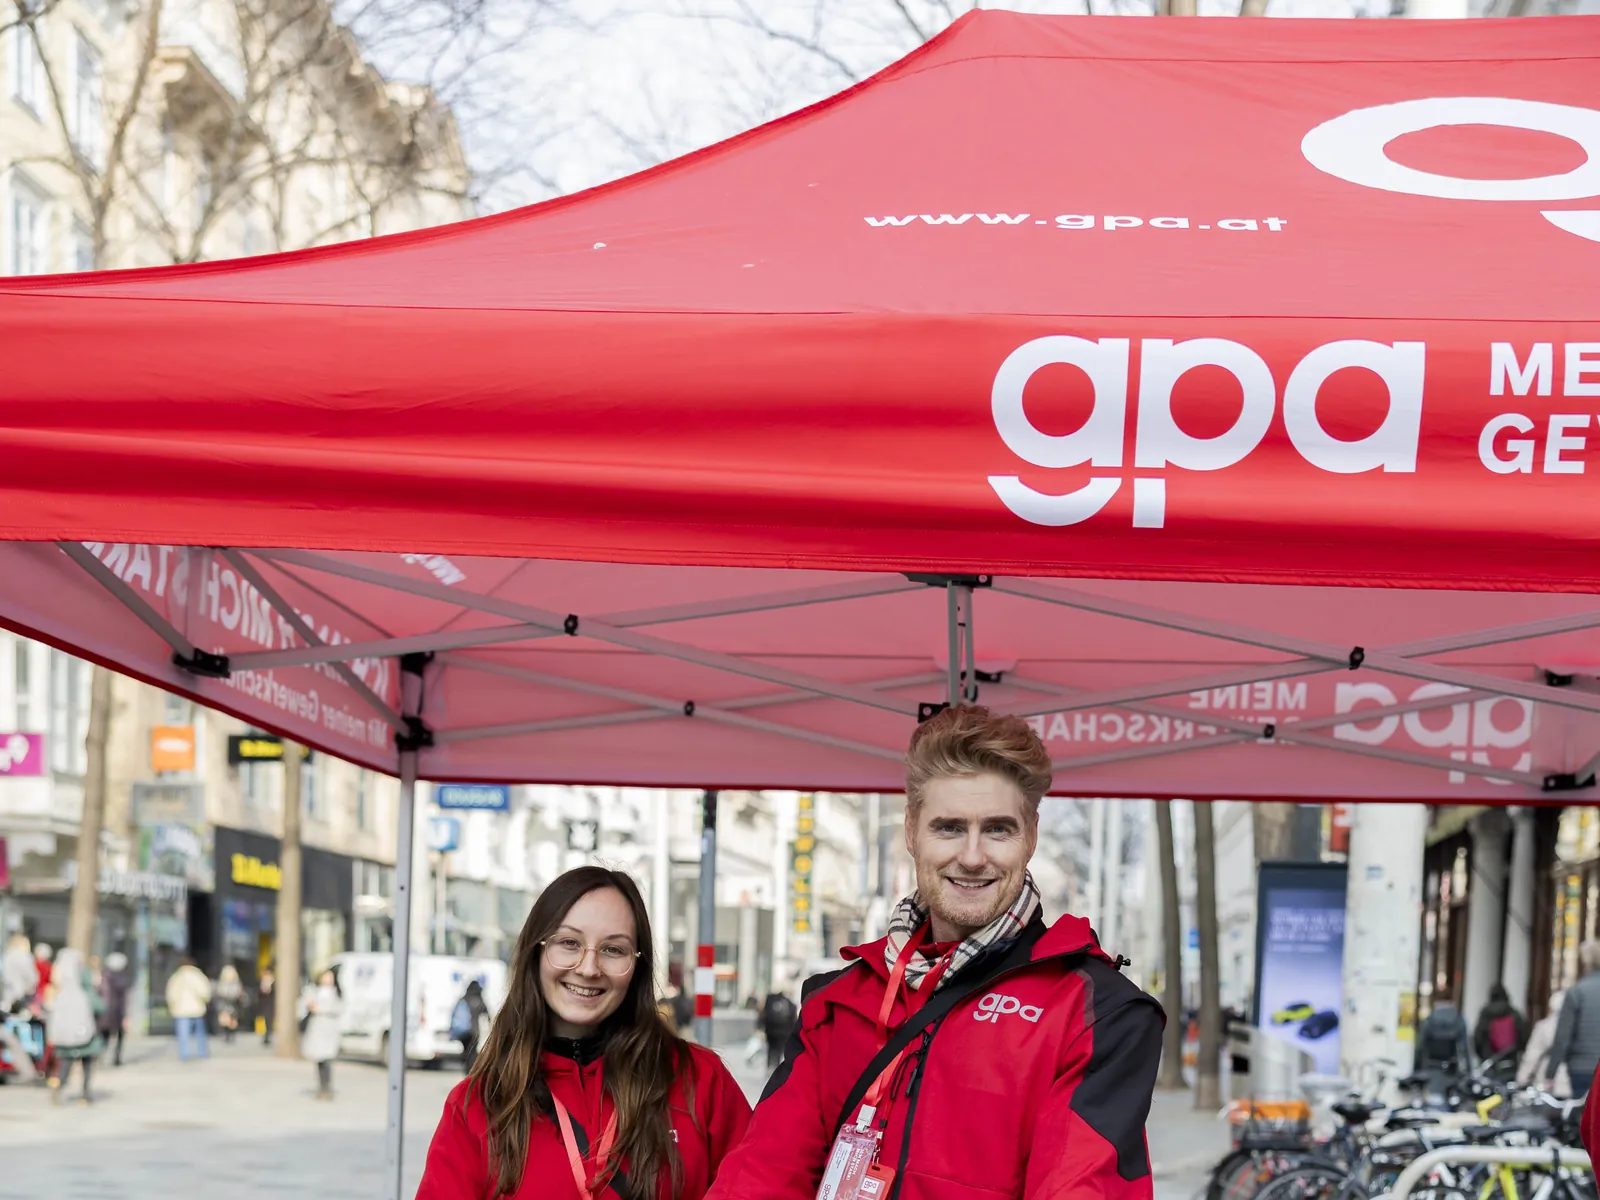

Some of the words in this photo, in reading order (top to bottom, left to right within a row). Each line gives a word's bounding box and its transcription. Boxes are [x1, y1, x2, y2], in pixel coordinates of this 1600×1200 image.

[864, 213, 1287, 232] www.gpa.at
[988, 335, 1425, 528] gpa
[1478, 413, 1600, 474] GE
[973, 993, 1044, 1023] gpa
